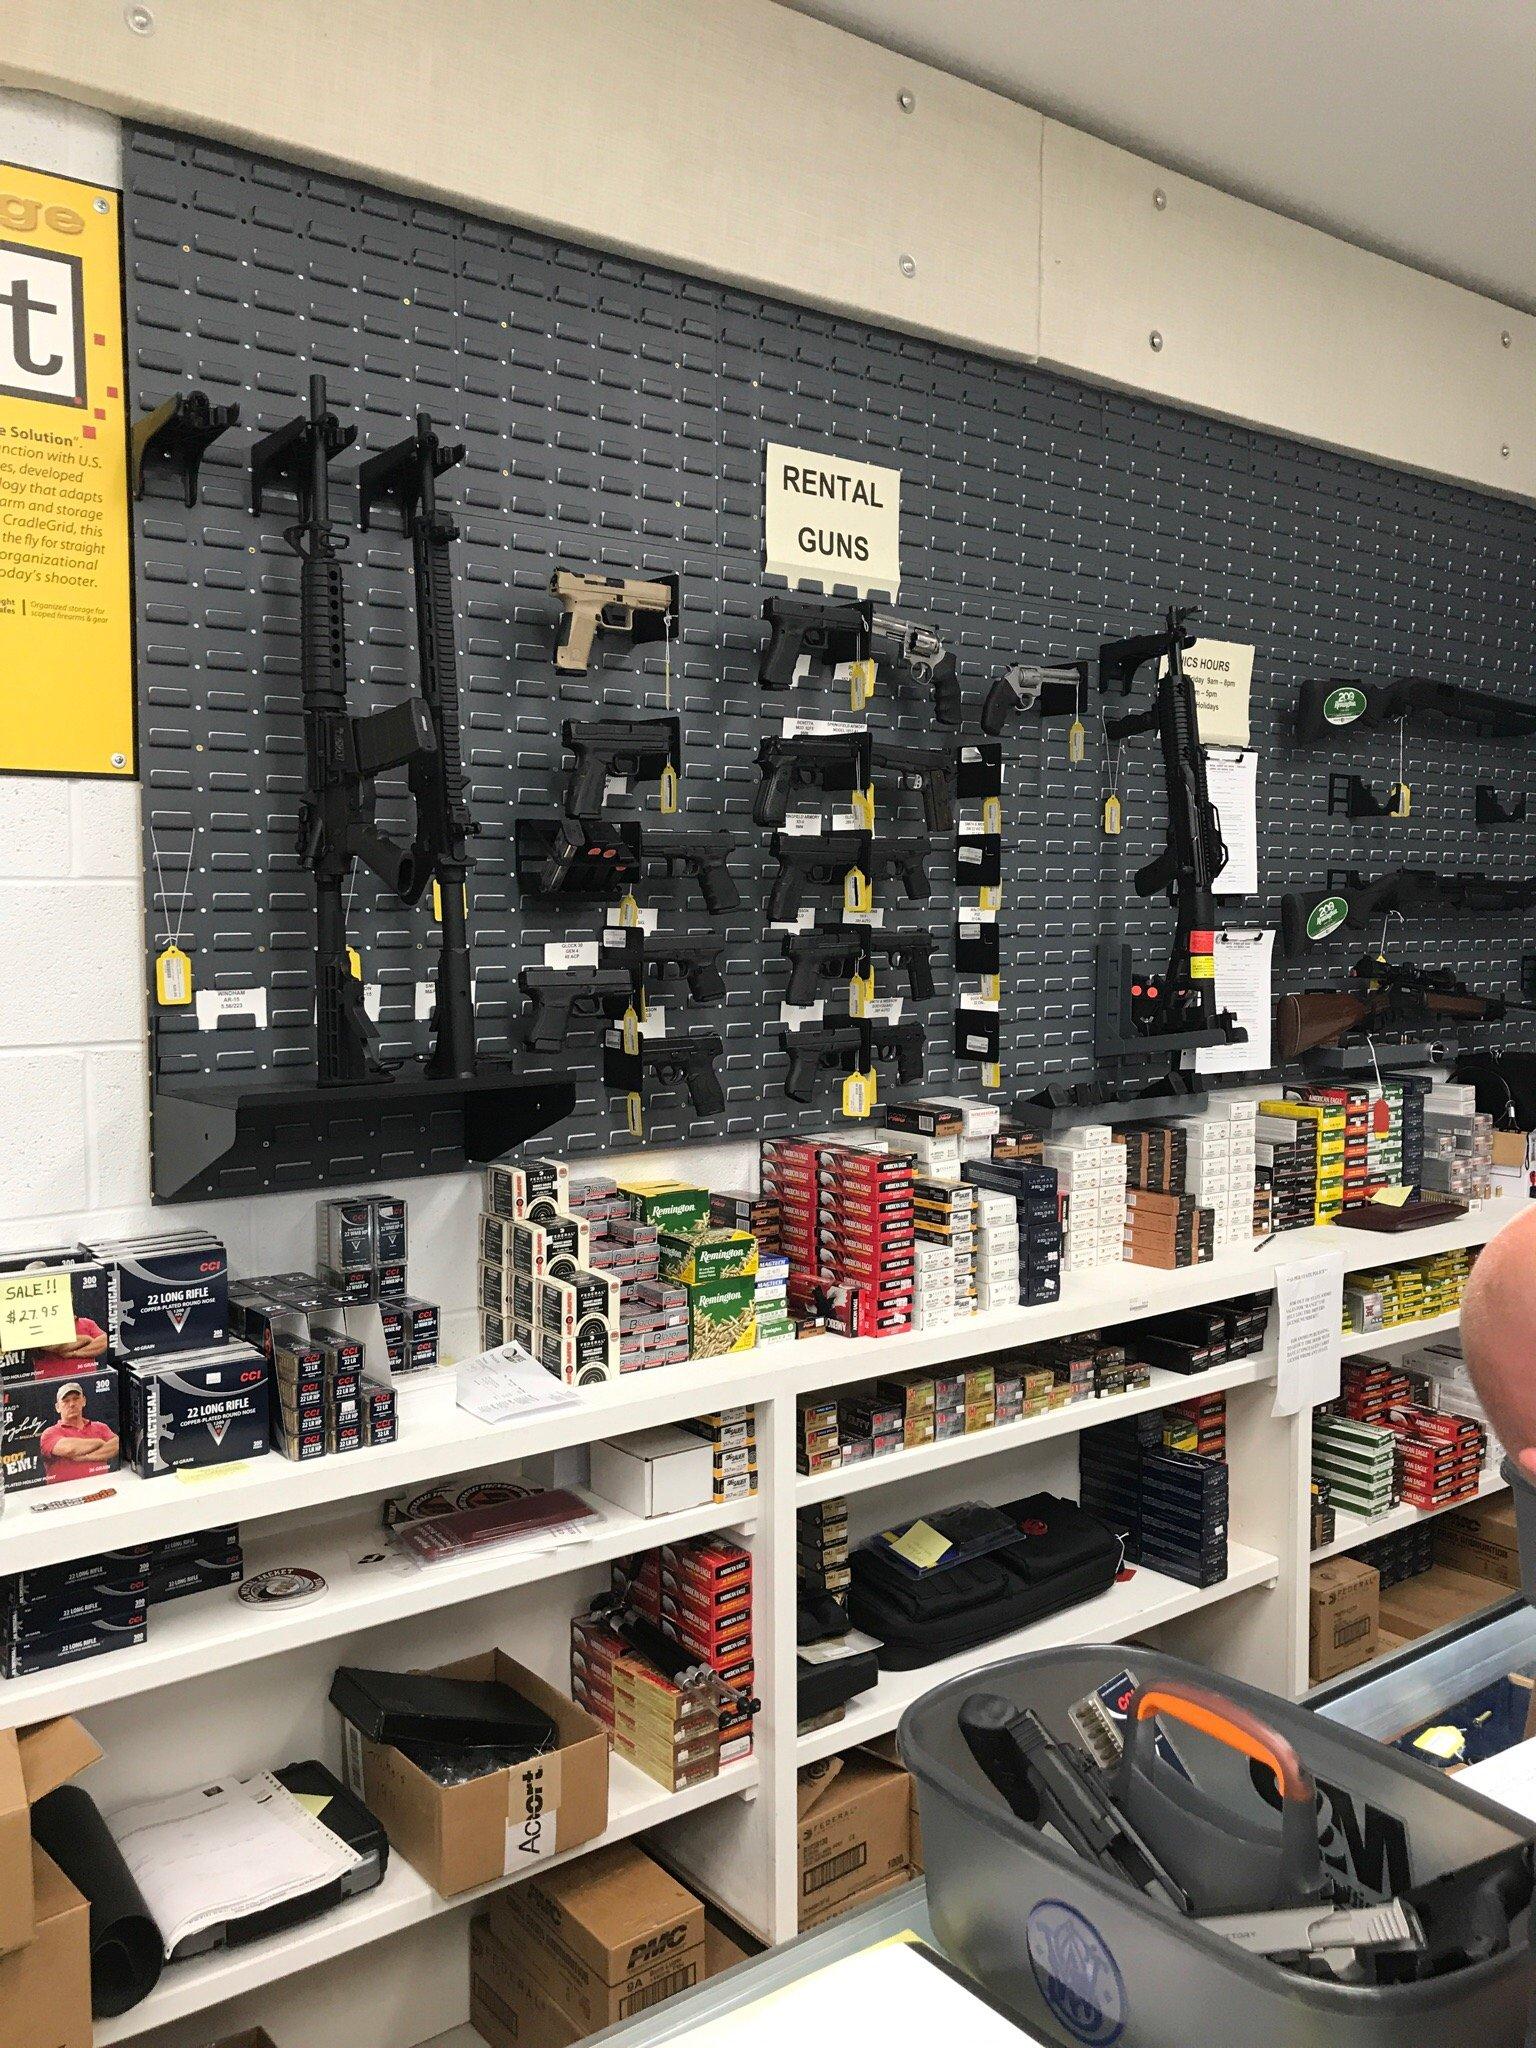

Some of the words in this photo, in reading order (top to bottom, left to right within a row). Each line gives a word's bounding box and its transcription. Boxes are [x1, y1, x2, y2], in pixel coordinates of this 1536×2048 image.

[47, 451, 75, 464] with
[78, 455, 102, 469] U.S.
[19, 463, 84, 483] developed
[29, 482, 57, 496] that
[60, 488, 103, 504] adapts
[783, 465, 884, 508] RENTAL
[28, 502, 53, 514] and
[57, 505, 104, 522] storage
[3, 513, 77, 535] CradleGrid,
[80, 524, 103, 537] this
[2, 531, 22, 544] the
[25, 533, 39, 549] fly
[41, 535, 58, 548] for
[60, 541, 106, 556] straight
[798, 527, 869, 561] GUNS
[45, 572, 98, 588] shooter.
[1200, 658, 1230, 672] HOURS
[1197, 702, 1219, 712] Holidays
[652, 1203, 696, 1217] Remington
[699, 1248, 744, 1262] Remington
[200, 1260, 221, 1272] CCI
[83, 1275, 97, 1286] 300
[147, 1294, 159, 1305] 22
[160, 1291, 184, 1303] LONG
[185, 1287, 209, 1300] RIFLE
[698, 1291, 742, 1307] Remington
[107, 1278, 118, 1335] TACTICAL
[109, 1336, 119, 1349] AR
[342, 1346, 358, 1356] CCI
[240, 1370, 262, 1382] CCI
[96, 1379, 110, 1389] 300
[302, 1383, 319, 1392] CCI
[375, 1393, 390, 1402] CCI
[187, 1407, 199, 1419] 22
[200, 1402, 225, 1416] LONG
[226, 1397, 249, 1411] RIFLE
[222, 1411, 242, 1420] ROUND
[242, 1408, 256, 1416] NOSE
[304, 1408, 320, 1418] CCI
[147, 1392, 158, 1448] TACTICAL
[376, 1420, 391, 1429] CCI
[304, 1434, 320, 1444] CCI
[341, 1428, 357, 1437] CCI
[147, 1448, 158, 1464] AR
[6, 1456, 38, 1475] EM!
[627, 1924, 688, 1970] PMC
